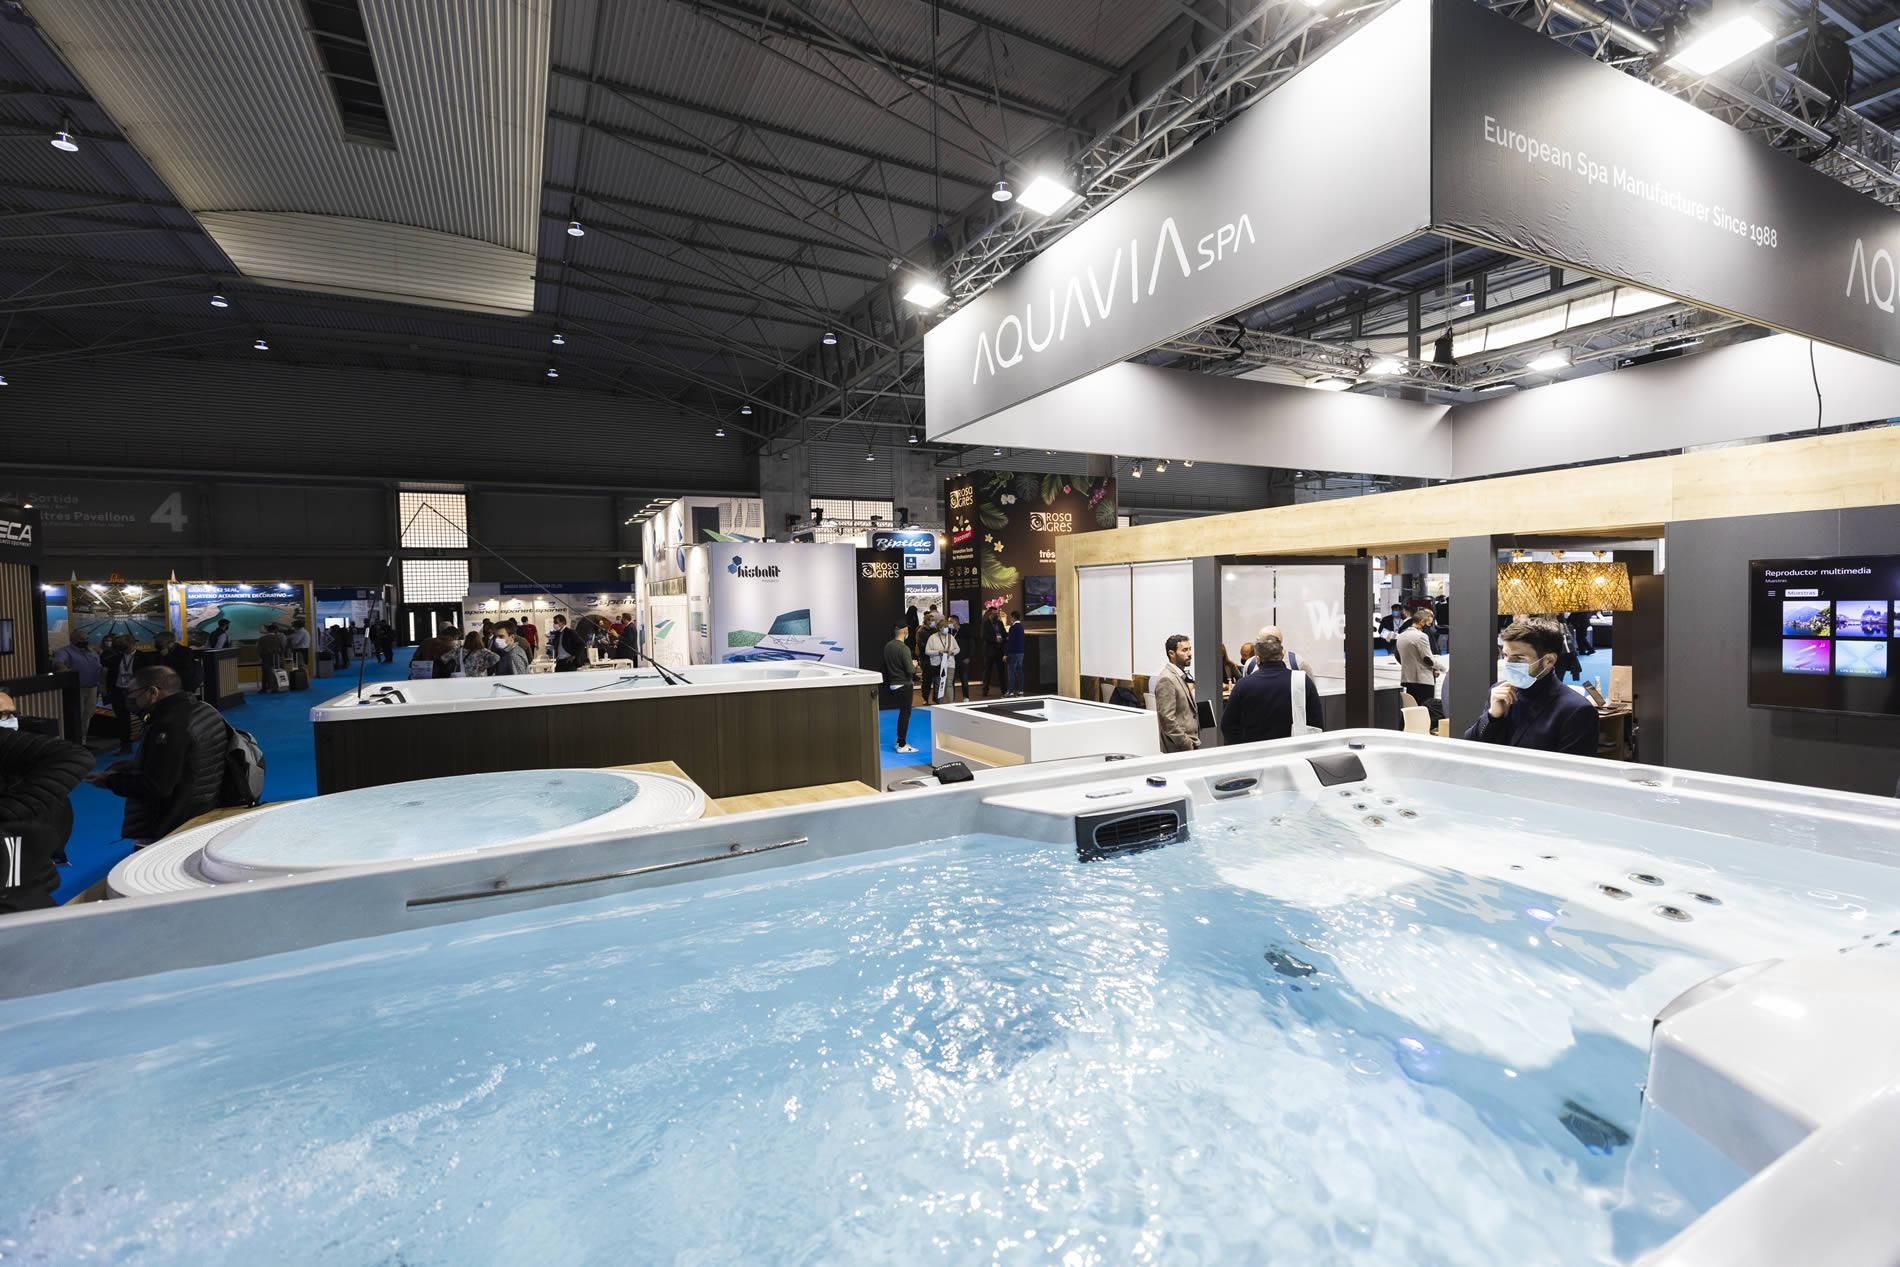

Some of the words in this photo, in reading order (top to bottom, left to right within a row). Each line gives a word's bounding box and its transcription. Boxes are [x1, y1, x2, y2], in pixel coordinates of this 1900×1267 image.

[1484, 115, 1571, 170] European
[1576, 152, 1608, 185] Spa
[1613, 165, 1710, 222] Manufacturer
[1712, 205, 1747, 237] Since
[1750, 223, 1777, 248] 1988
[1846, 238, 1900, 313] AQ
[972, 217, 1191, 385] AQUAVIA
[1197, 214, 1256, 272] SPA
[74, 511, 135, 522] Pavellons
[150, 491, 188, 532] 4
[875, 538, 932, 548] Riptide
[737, 565, 781, 578] hisbalit
[1765, 569, 1818, 578] Reproductor
[1820, 566, 1872, 575] multimedia
[599, 599, 637, 607] spane
